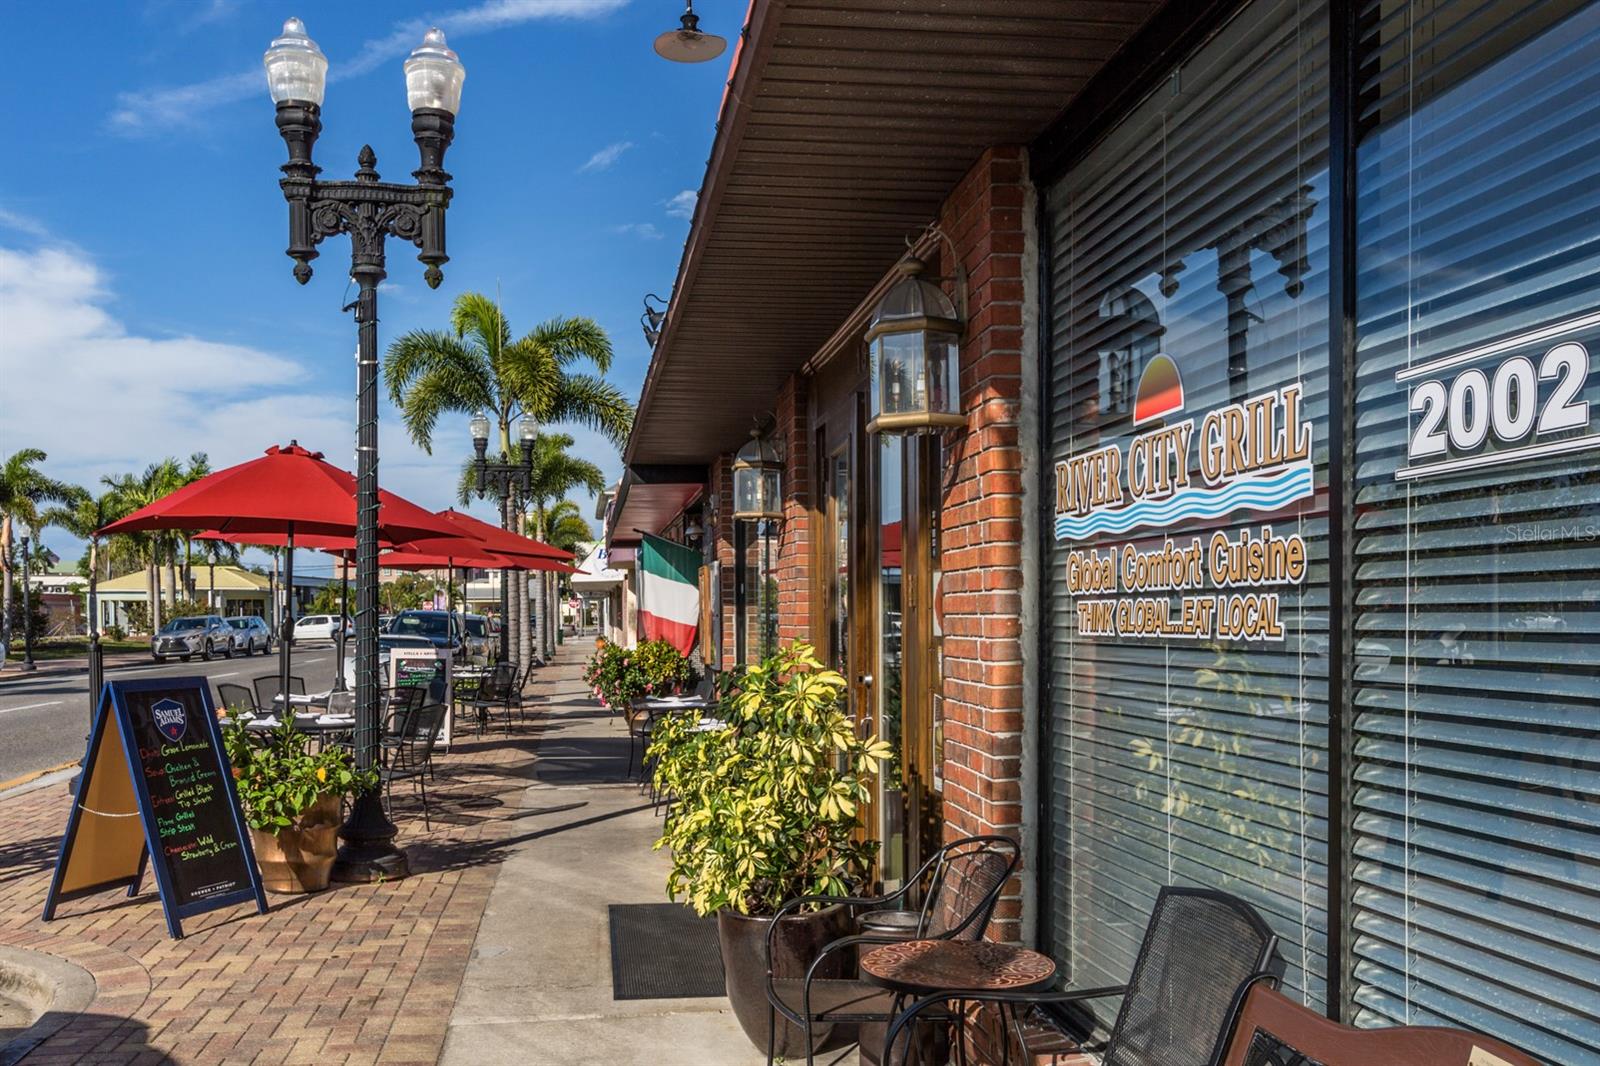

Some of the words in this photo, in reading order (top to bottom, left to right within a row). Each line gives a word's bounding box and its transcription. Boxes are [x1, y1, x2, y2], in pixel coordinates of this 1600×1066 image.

[1408, 341, 1591, 459] 2002
[1055, 445, 1123, 515] RIVER
[1128, 419, 1194, 498] CITY
[1200, 383, 1312, 482] GRILL
[1066, 546, 1117, 595] Global
[1122, 535, 1203, 593] Comfort
[1209, 525, 1307, 588] Cuisine
[1078, 599, 1115, 636] THINK
[1217, 593, 1284, 641] LOCAL
[155, 707, 184, 720] SAMUEL
[160, 714, 184, 727] ADAMS
[196, 834, 214, 847] Wild
